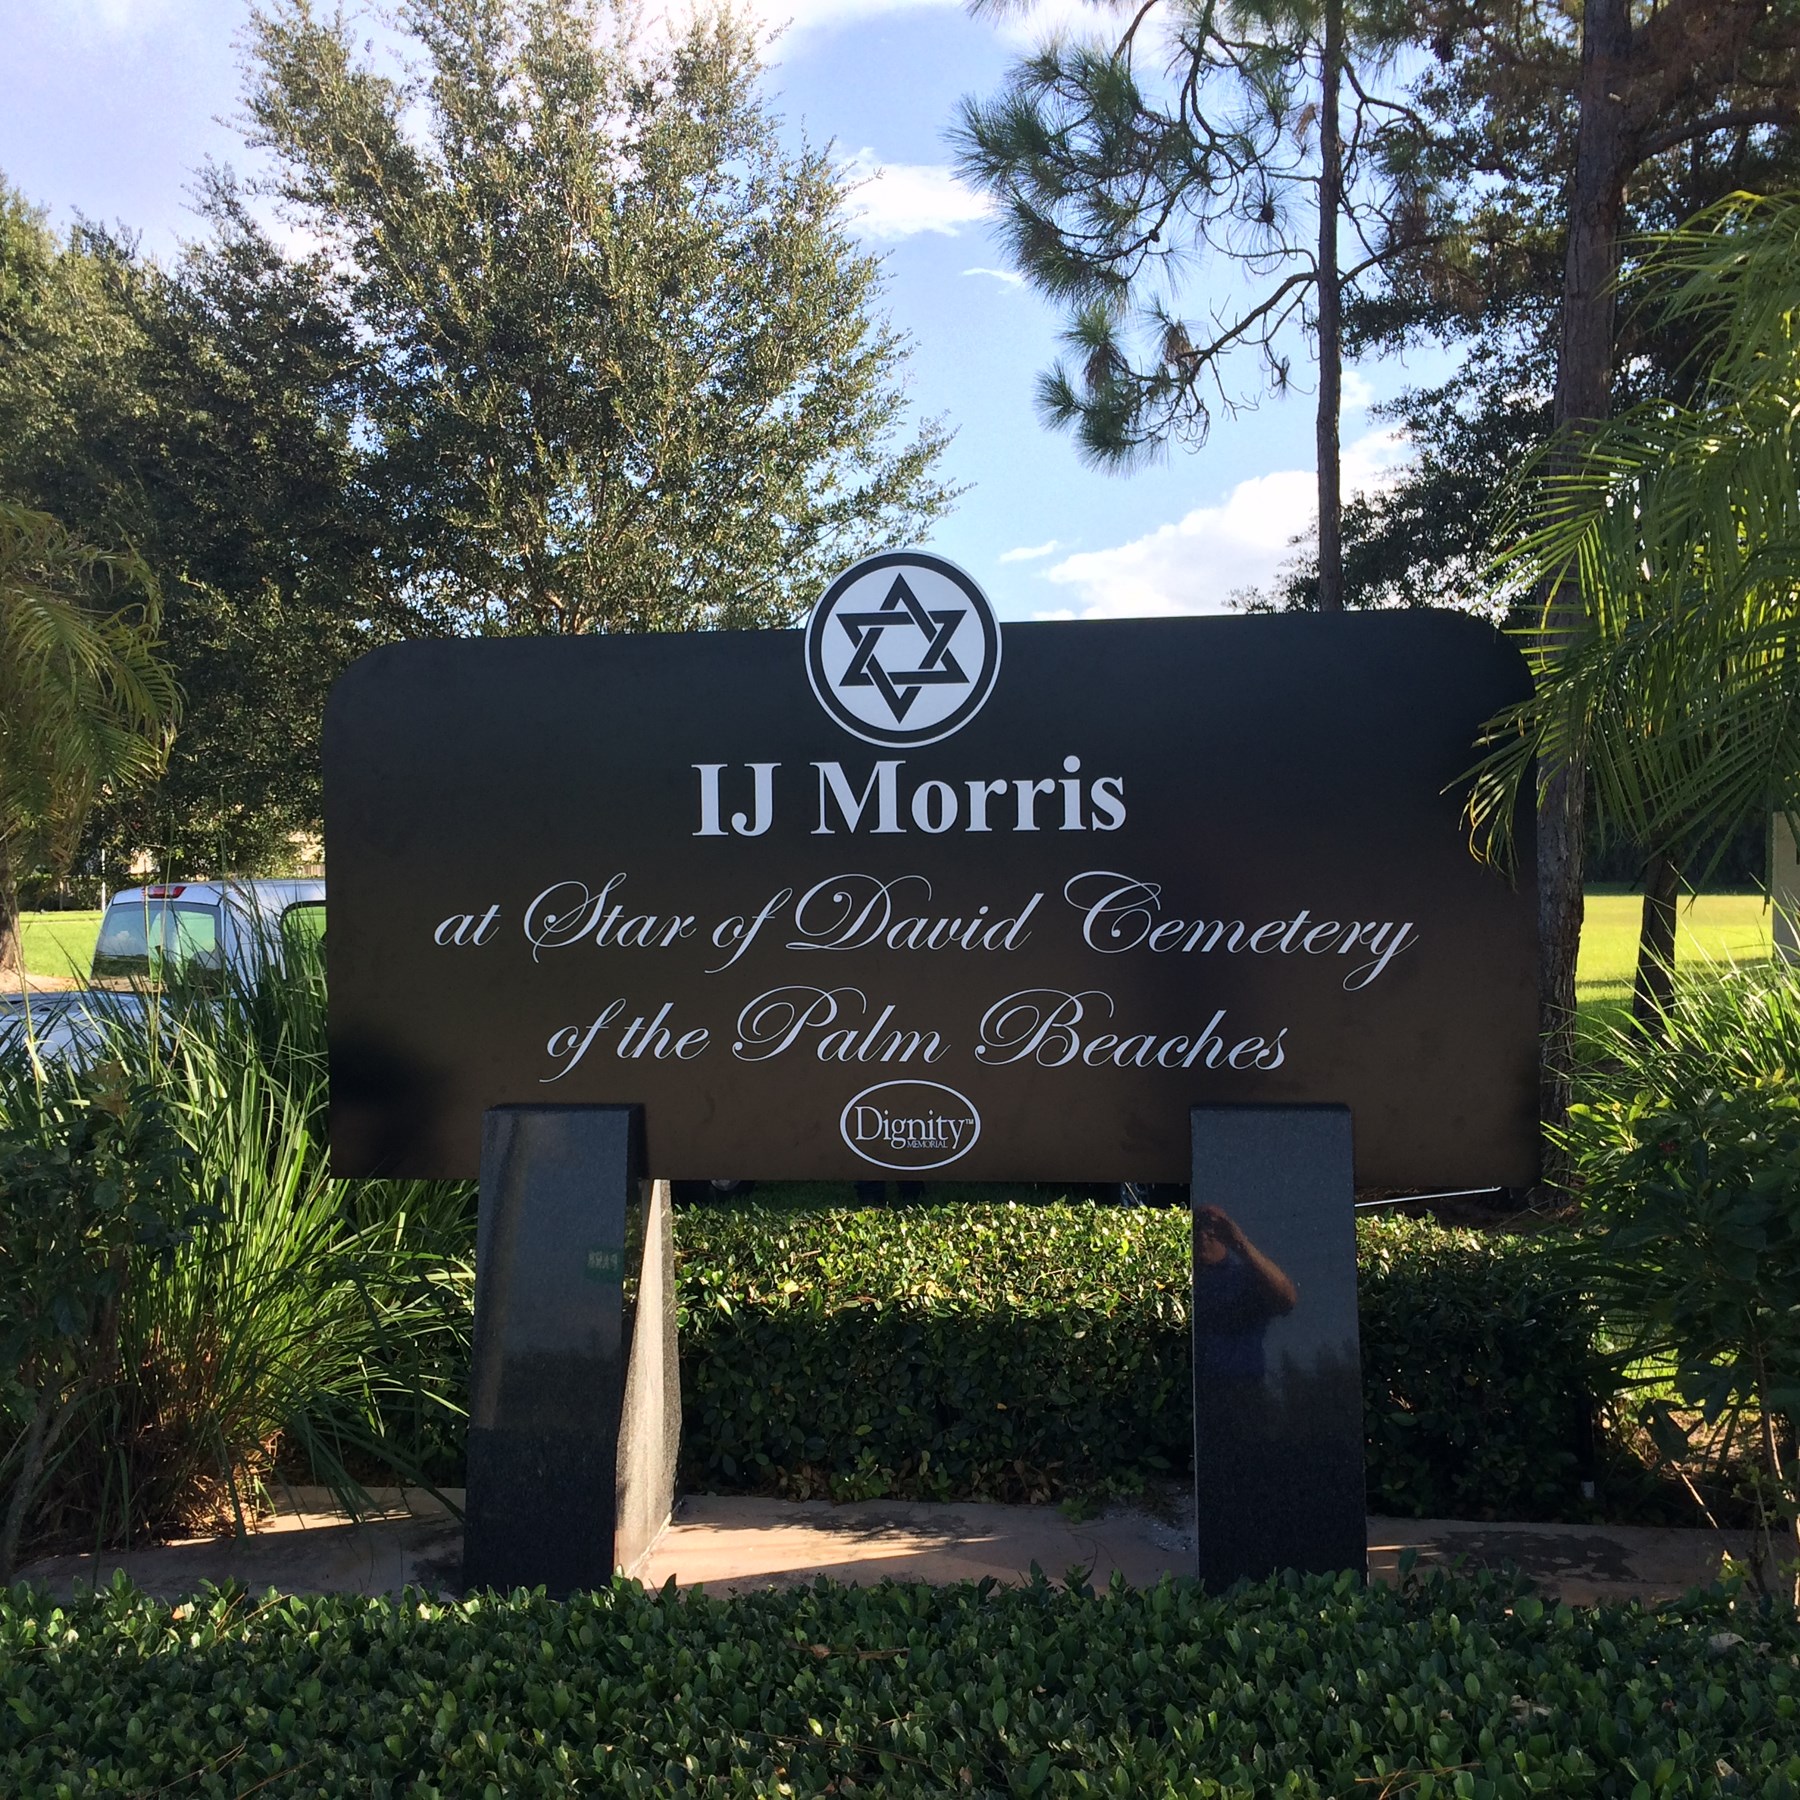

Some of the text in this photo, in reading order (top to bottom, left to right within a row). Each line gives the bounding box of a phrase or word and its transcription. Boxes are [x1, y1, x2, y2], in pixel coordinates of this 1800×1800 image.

[692, 756, 1127, 836] IJ Morris
[434, 870, 1419, 991] at Star of David Cemetery
[540, 985, 1288, 1083] of the Palm Beaches
[855, 1106, 966, 1149] Dignity
[907, 1140, 948, 1149] MEMORIAL
